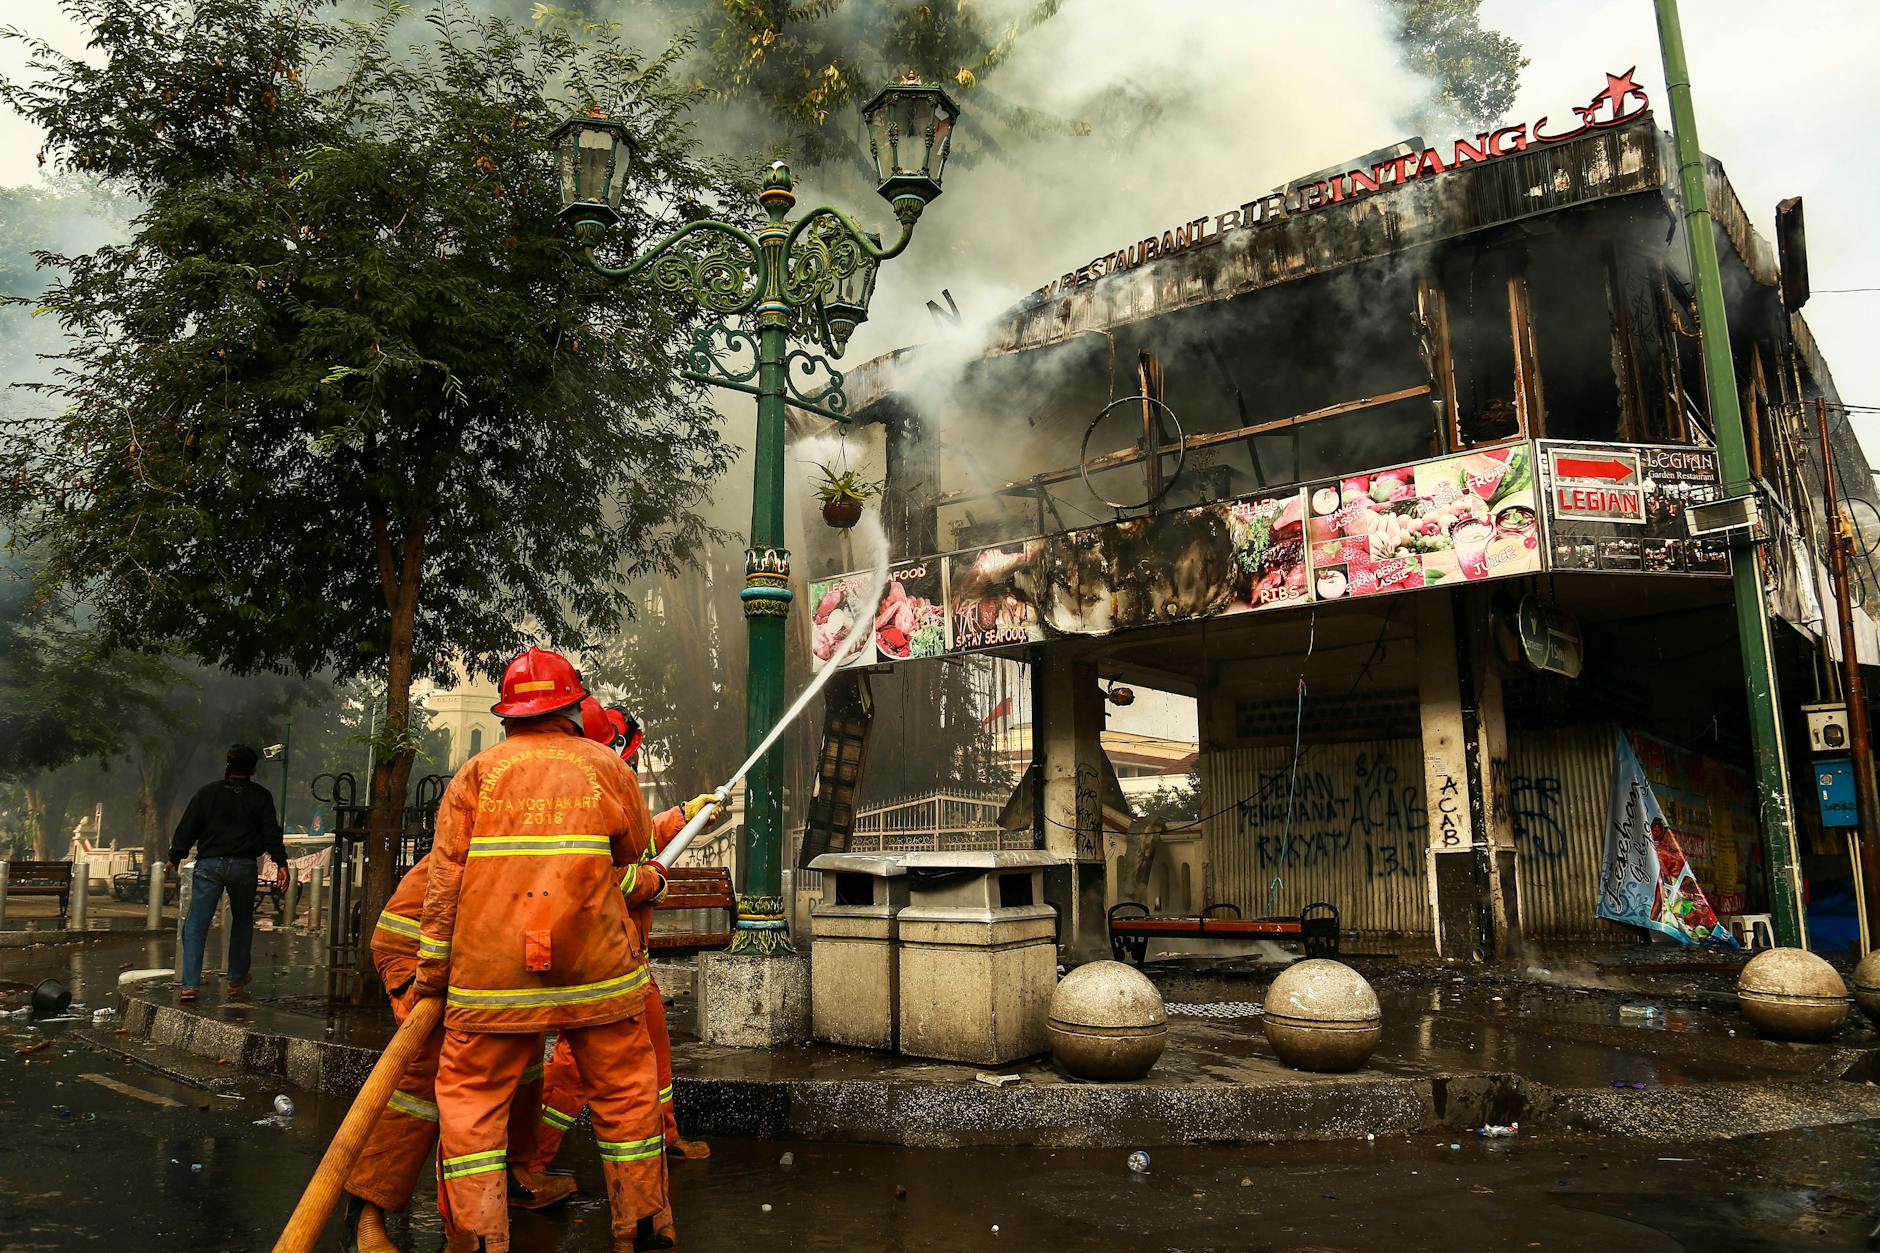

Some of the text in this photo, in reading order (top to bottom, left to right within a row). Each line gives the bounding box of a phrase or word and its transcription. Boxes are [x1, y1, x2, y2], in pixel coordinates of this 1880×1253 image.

[1059, 122, 1528, 293] RESTAURANT BIR BINTANG
[1645, 451, 1714, 472] LEGIAN
[1648, 470, 1715, 482] Garden Restaurant
[1416, 484, 1464, 517] FRESH
[1465, 462, 1513, 493] FRUIT
[1558, 488, 1639, 513] LEGIAN
[1226, 498, 1279, 516] RILLED
[1326, 500, 1359, 524] MANGO
[1472, 545, 1517, 576] JUICE
[827, 566, 926, 594] LEGIA AFOOD
[1345, 560, 1404, 592] STRAWBERRY
[1373, 569, 1409, 591] LASSIE
[1260, 585, 1300, 604] RIBS
[984, 627, 1025, 645] SEAFOOD
[480, 750, 534, 801] PEMADAM
[478, 799, 513, 812] KOTA
[1342, 785, 1429, 851] ACAB
